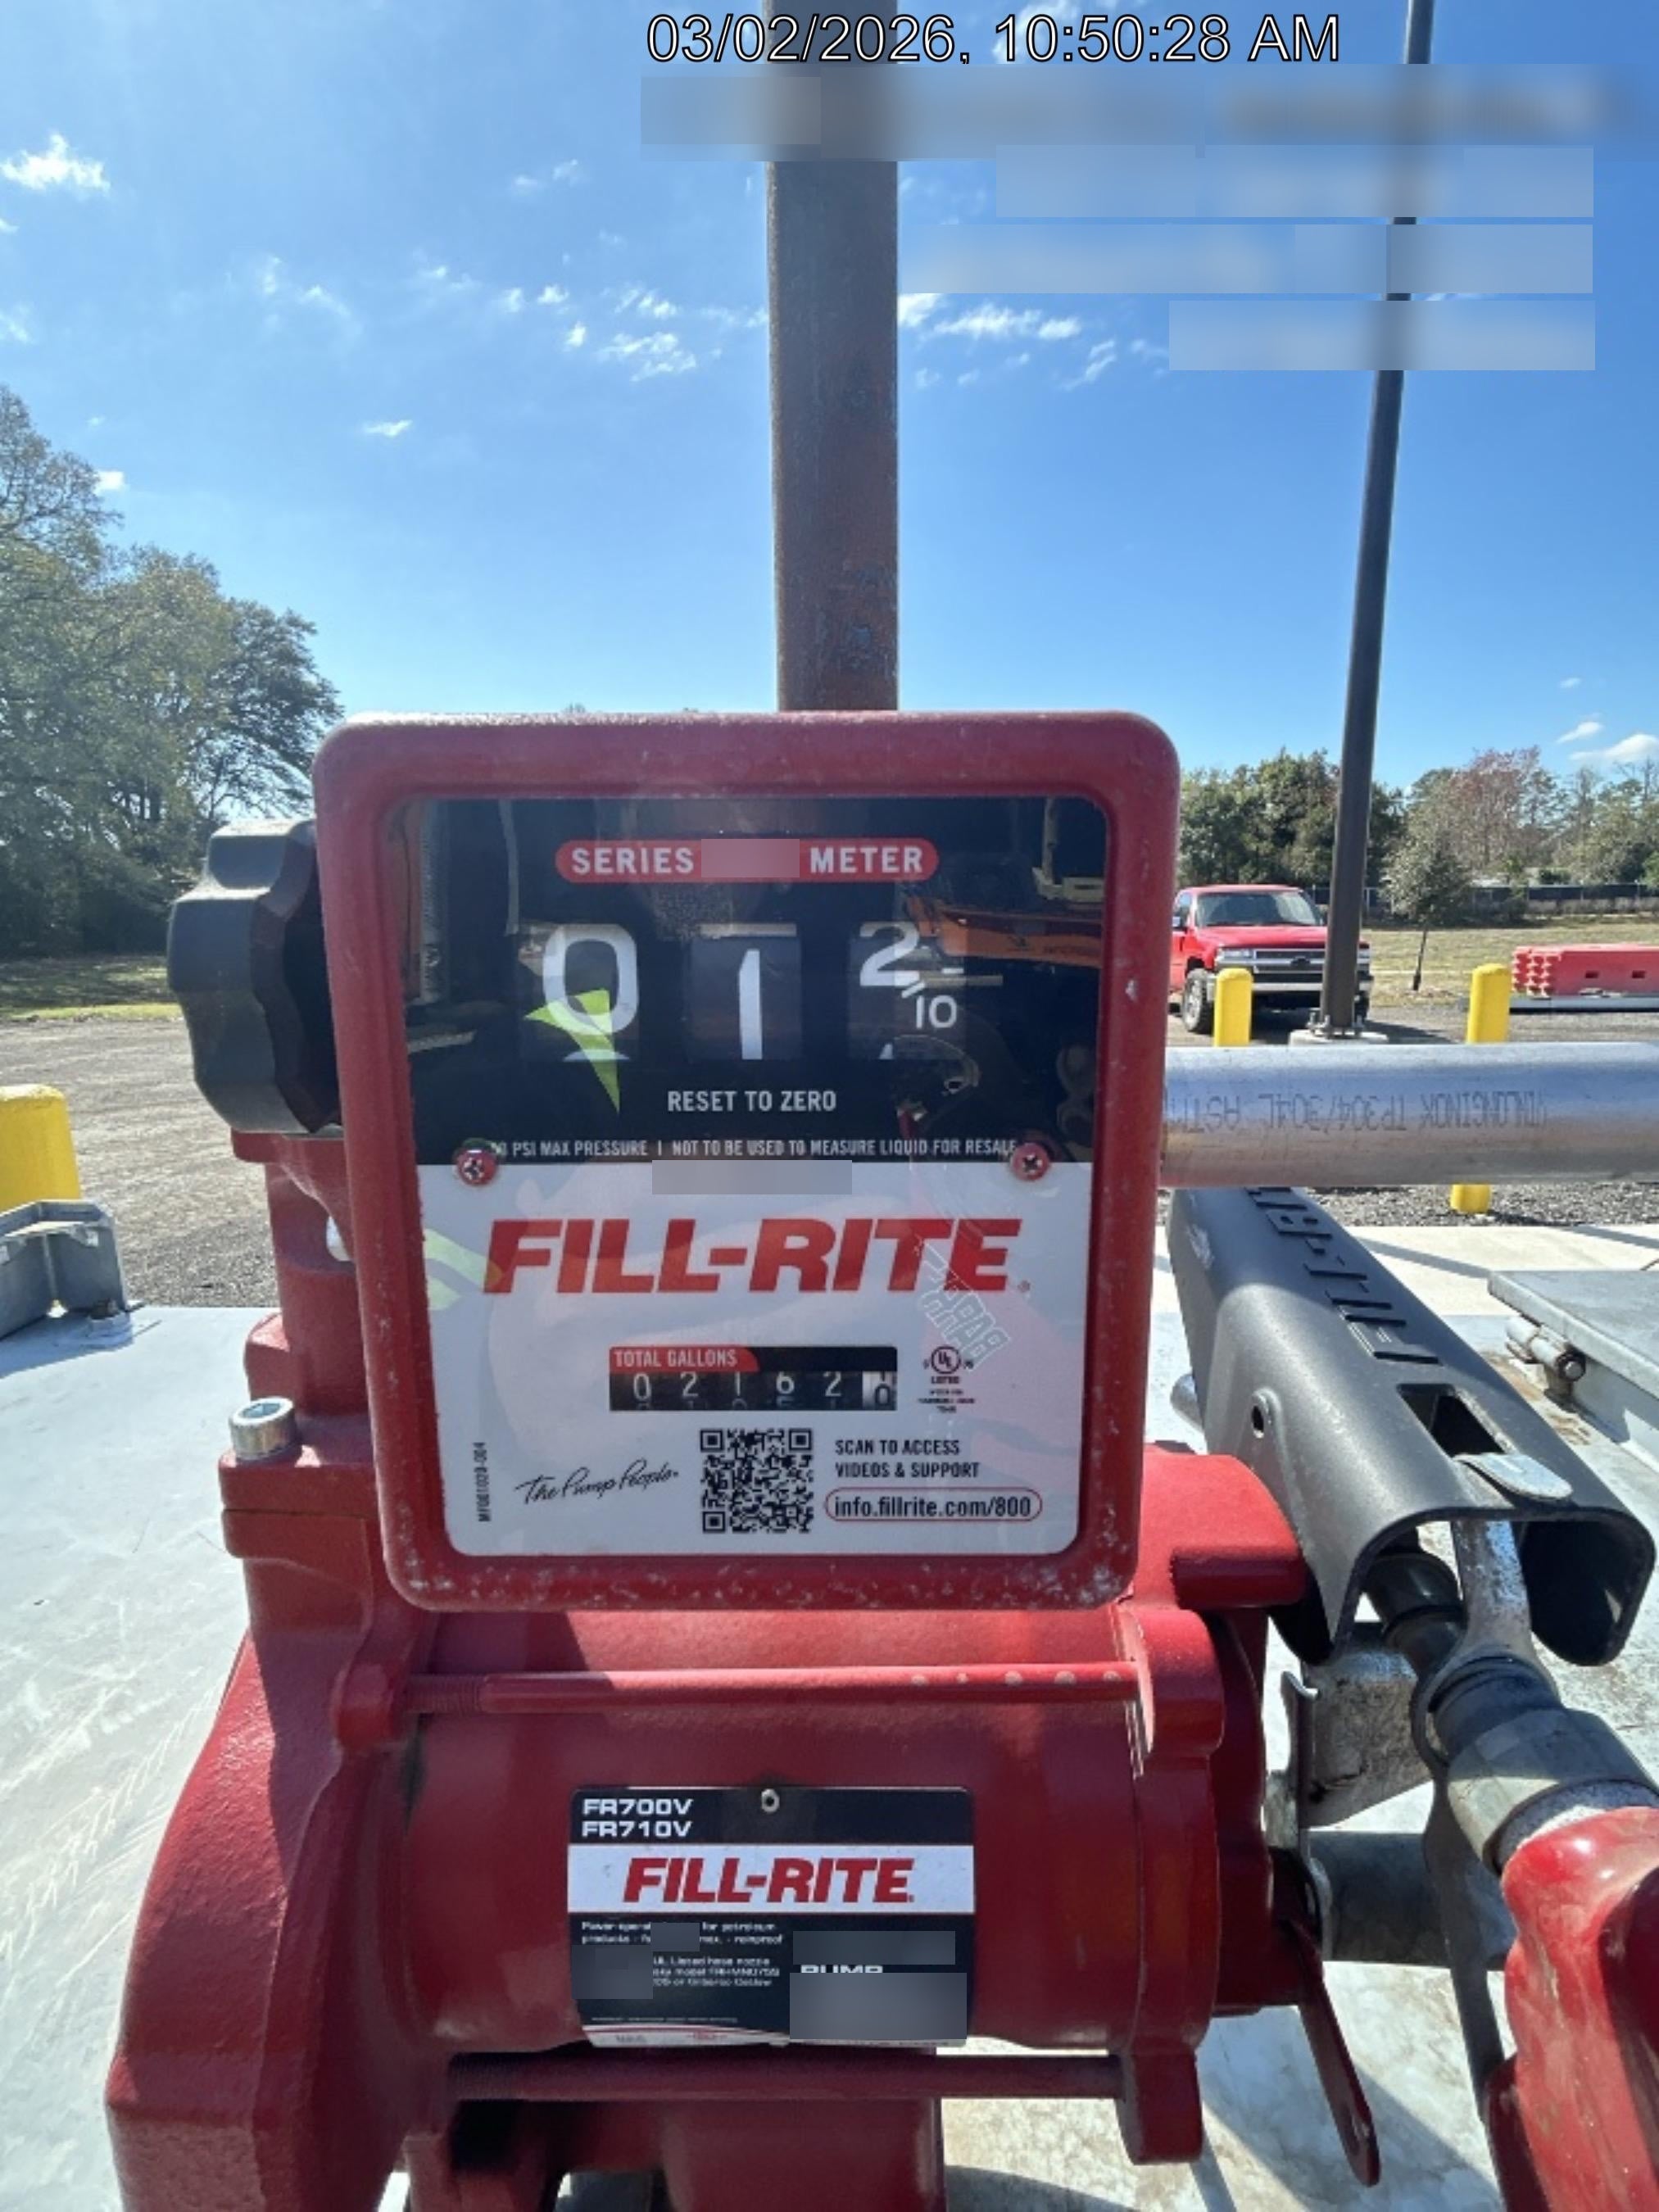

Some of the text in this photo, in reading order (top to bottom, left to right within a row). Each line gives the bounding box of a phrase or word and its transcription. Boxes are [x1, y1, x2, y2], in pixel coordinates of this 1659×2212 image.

[572, 846, 922, 874] SERIES METER
[668, 1090, 836, 1112] RESET TO ZERO
[512, 1140, 537, 1156] PSI
[540, 1140, 572, 1156] MAX
[574, 1140, 648, 1156] PRESSURE
[673, 1140, 698, 1156] NOT
[704, 1140, 722, 1156] TO
[724, 1140, 743, 1155] BE
[746, 1140, 784, 1155] USED
[788, 1140, 805, 1155] TO
[809, 1140, 876, 1155] MEASURE
[880, 1140, 927, 1155] LIQUID
[932, 1140, 960, 1155] FOR
[483, 1219, 1021, 1294] FILL-RITE
[614, 1349, 738, 1367] TOTAL GALLONS
[835, 1439, 959, 1455] SCAN TO ACCESS
[835, 1462, 980, 1478] VIDEOS & SUPPORT
[514, 1475, 560, 1505] The
[561, 1466, 617, 1500] Pump
[834, 1495, 1031, 1518] info.fillrite.com/800
[582, 1798, 693, 1815] FR700V
[582, 1820, 693, 1838] FR710V
[623, 1857, 915, 1903] FILL-RITE
